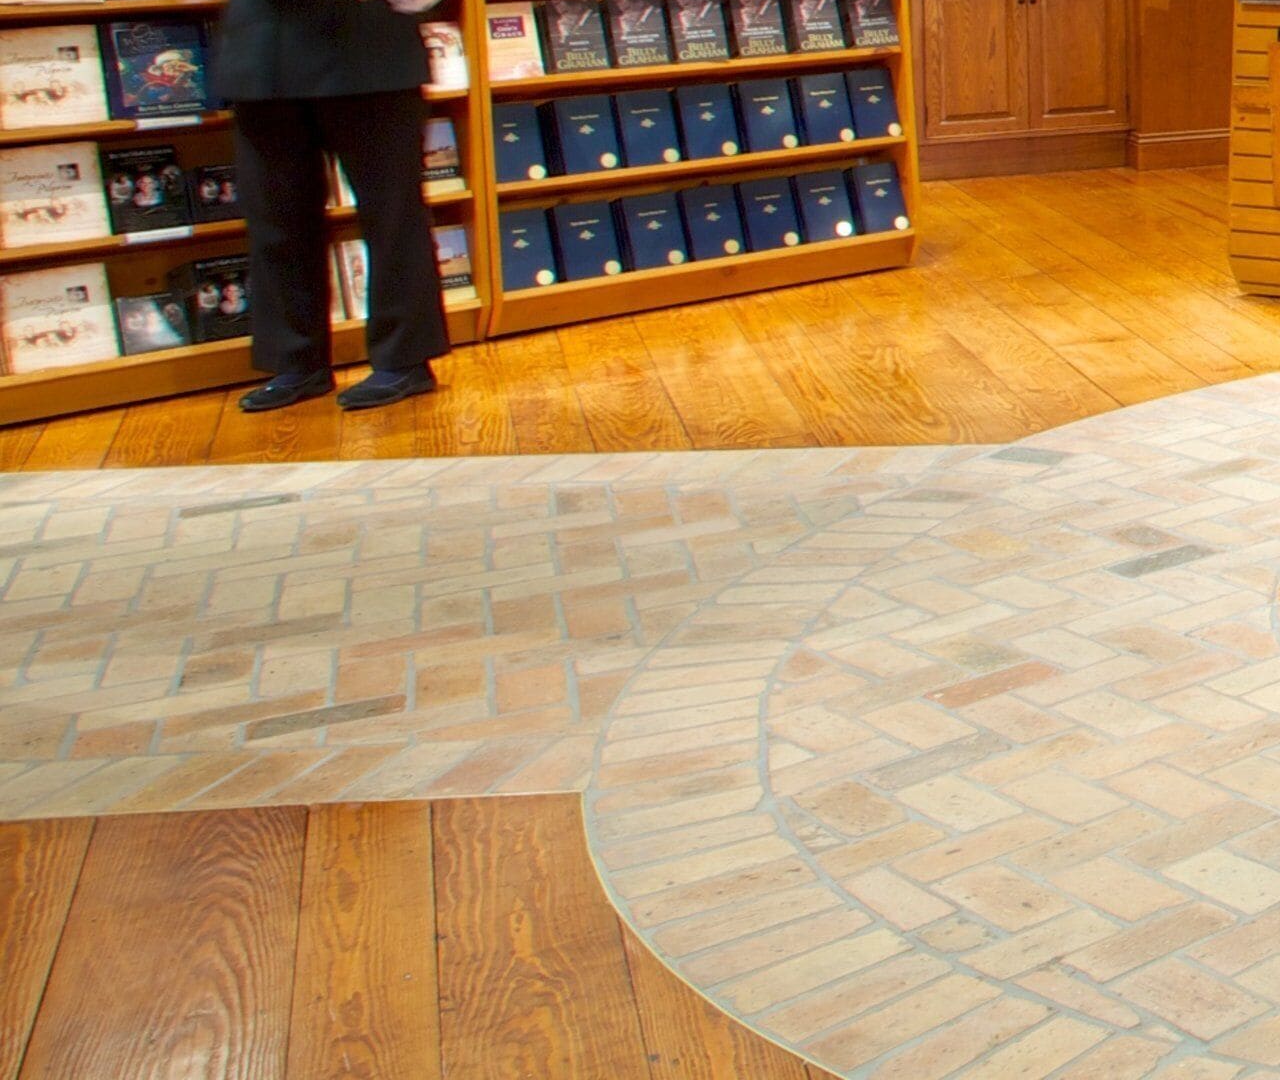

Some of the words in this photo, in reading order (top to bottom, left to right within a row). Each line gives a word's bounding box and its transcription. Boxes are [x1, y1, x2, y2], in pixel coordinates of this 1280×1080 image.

[807, 33, 834, 42] BILLY
[863, 28, 890, 38] BILLY
[687, 41, 718, 51] BILLY
[748, 38, 776, 49] BILLY
[800, 39, 844, 51] GRAHAM
[855, 35, 900, 47] GRAHAM
[565, 51, 596, 61] BILLY
[627, 46, 658, 56] BILLY
[679, 48, 727, 60] GRAHAM
[740, 46, 786, 57] GRAHAM
[557, 58, 609, 70] GRAHAM
[618, 54, 669, 66] GRAHAM
